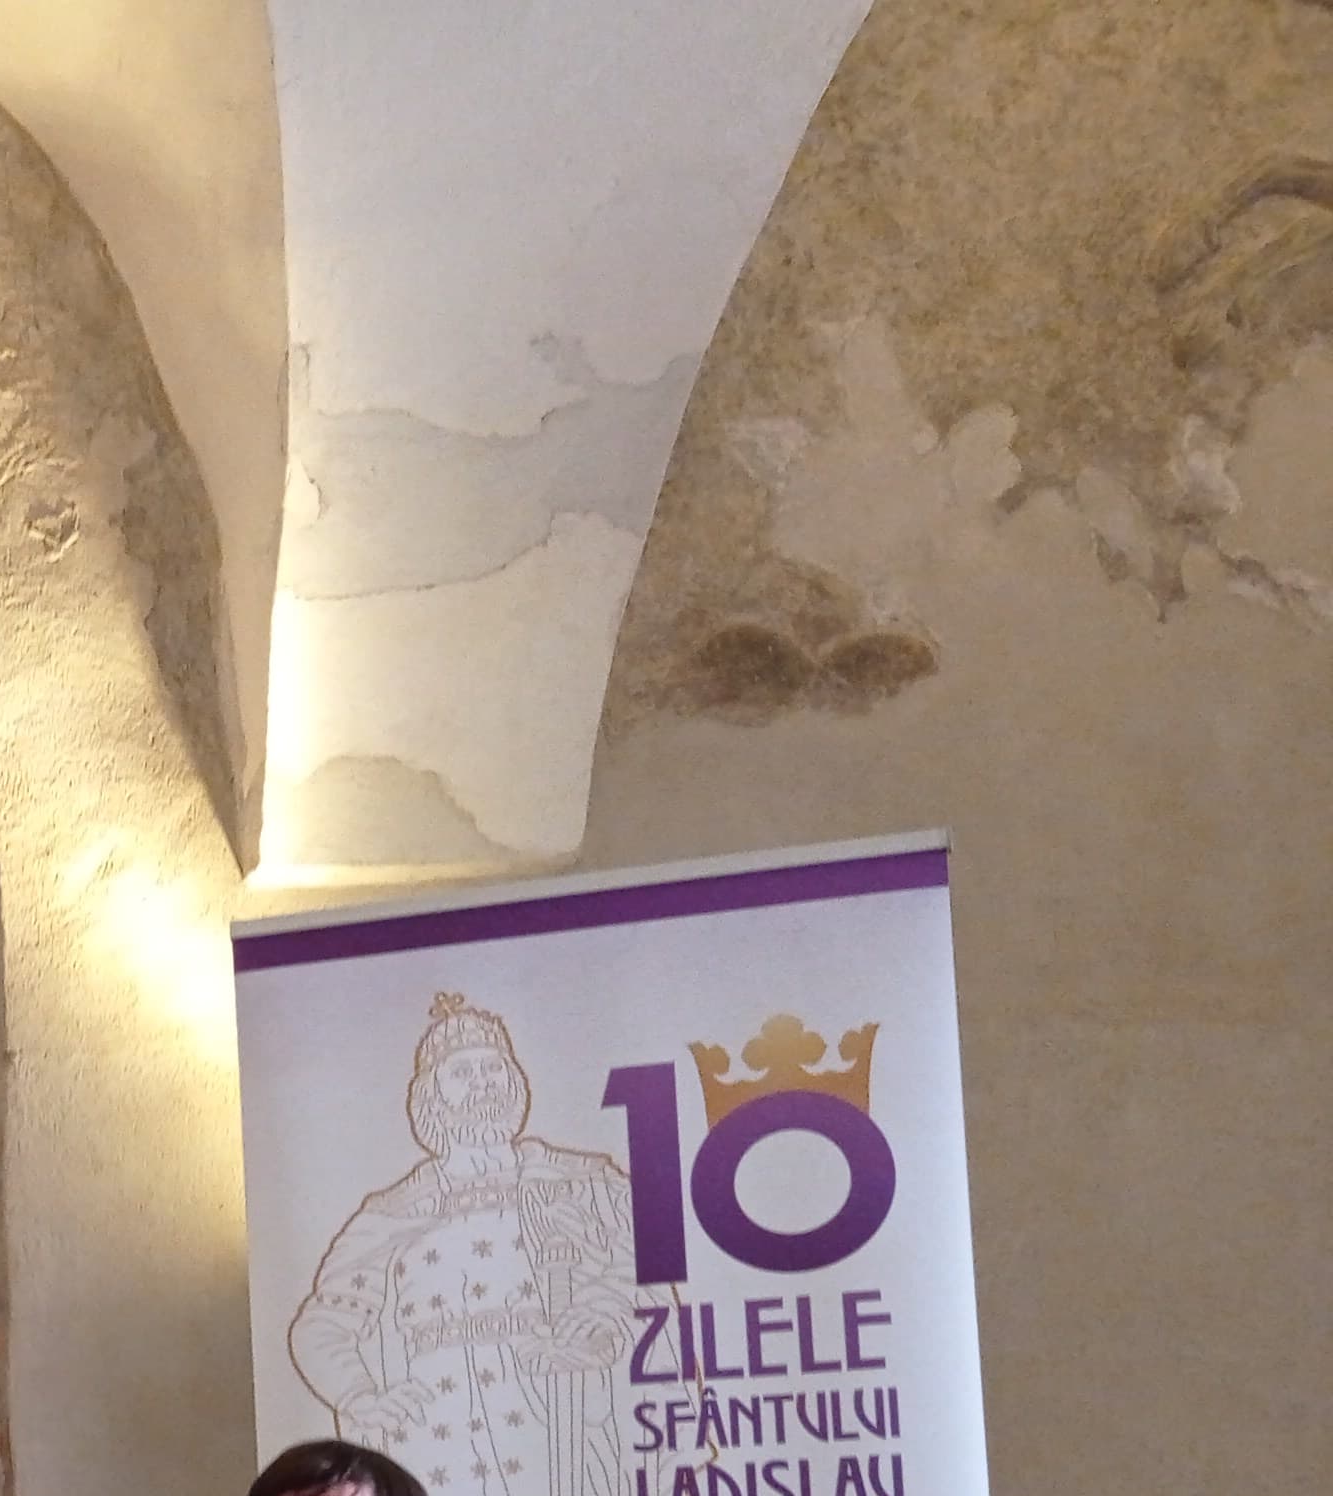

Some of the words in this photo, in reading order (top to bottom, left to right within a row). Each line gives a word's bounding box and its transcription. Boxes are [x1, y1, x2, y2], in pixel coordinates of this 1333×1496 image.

[601, 1061, 895, 1285] 10
[630, 1290, 892, 1385] ZILELE
[633, 1386, 901, 1452] SFÂNTULUI
